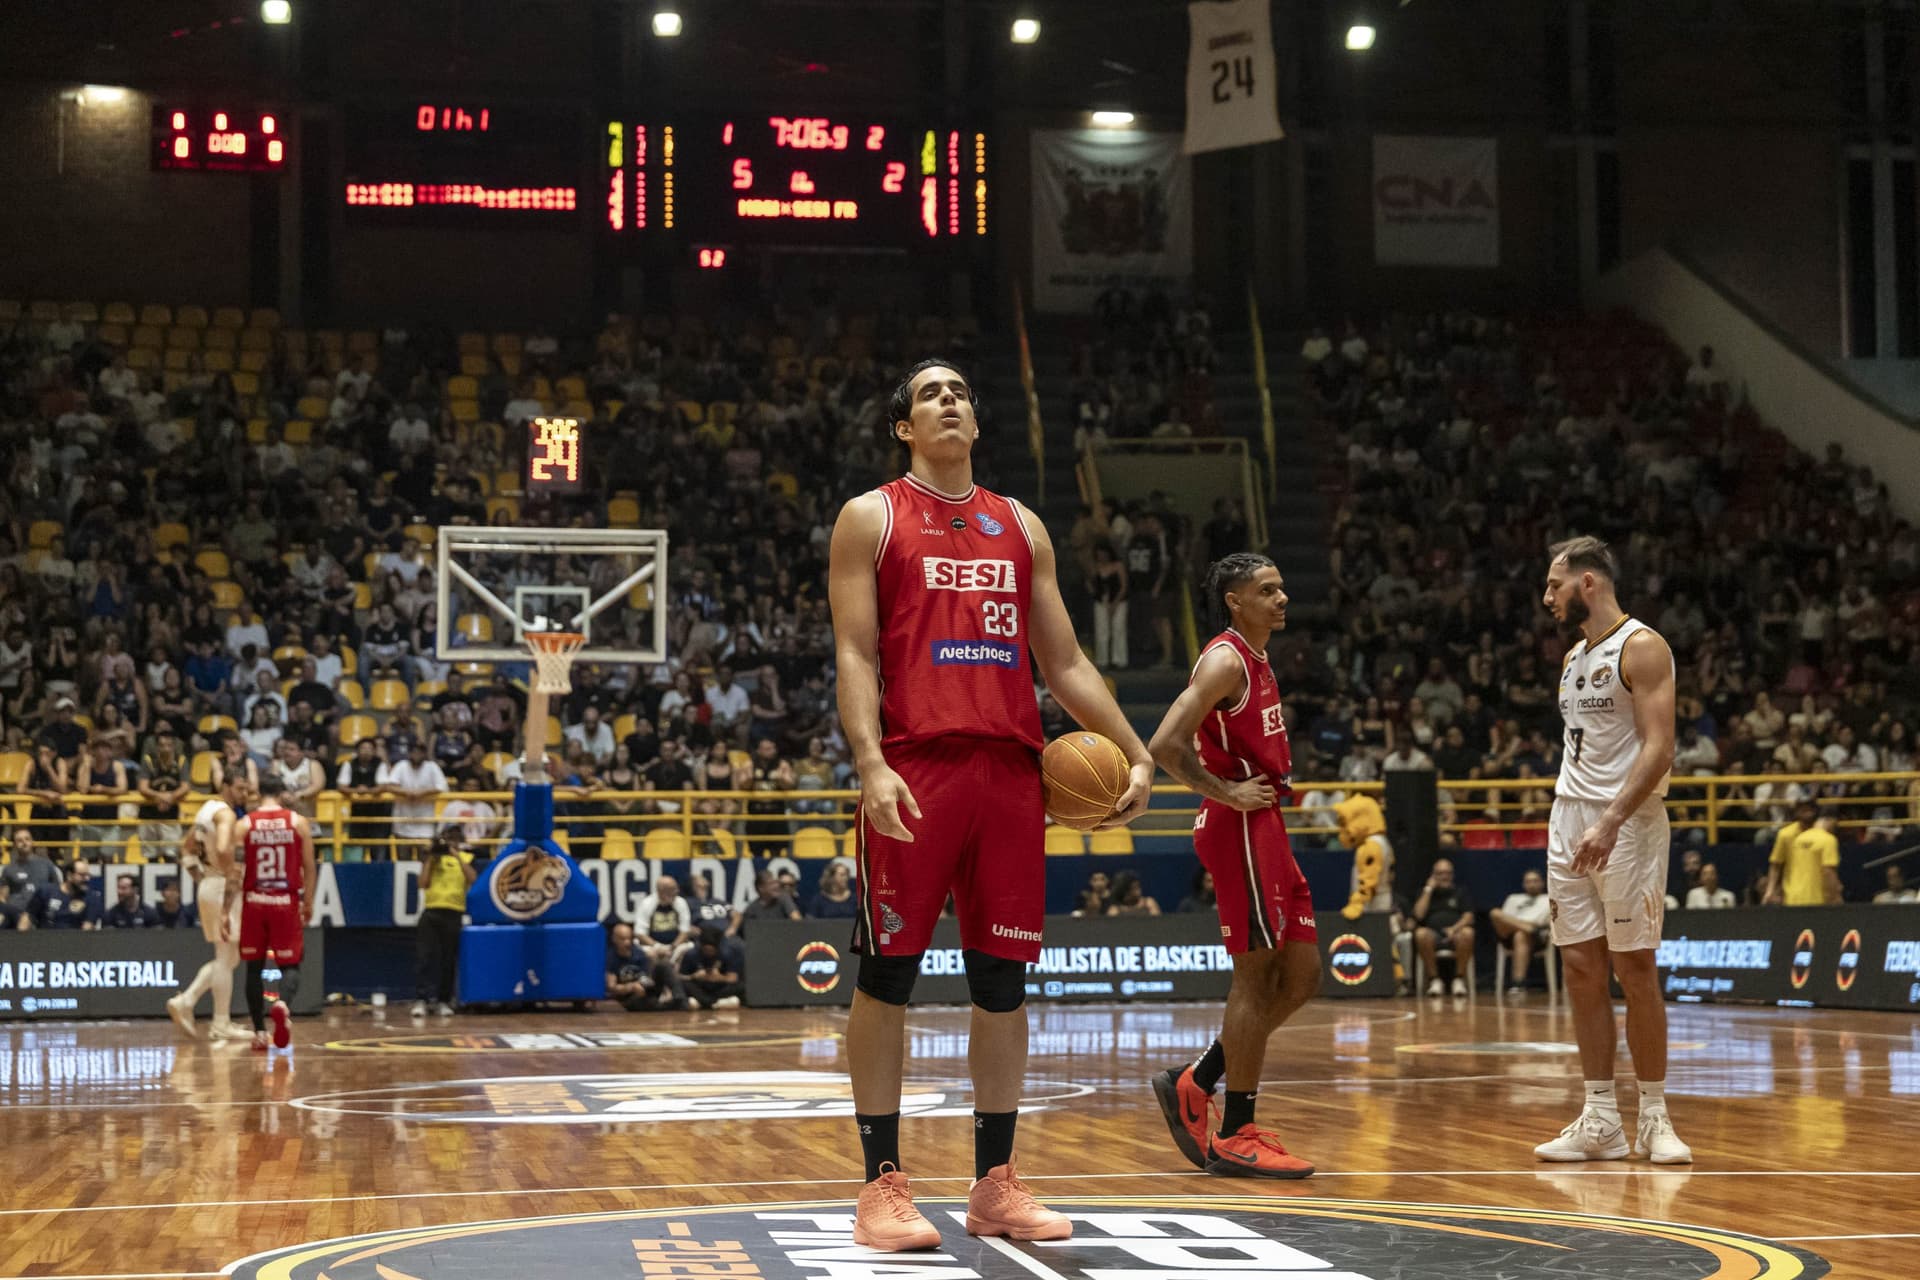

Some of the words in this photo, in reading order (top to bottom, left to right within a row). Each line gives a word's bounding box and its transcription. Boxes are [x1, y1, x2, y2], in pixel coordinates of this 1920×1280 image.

[1211, 56, 1254, 104] 24
[934, 561, 1008, 589] SESI
[982, 600, 1019, 638] 23
[256, 846, 287, 879] 21
[18, 962, 46, 989] DE
[50, 960, 180, 988] BASKETBALL
[1115, 947, 1142, 973] DE
